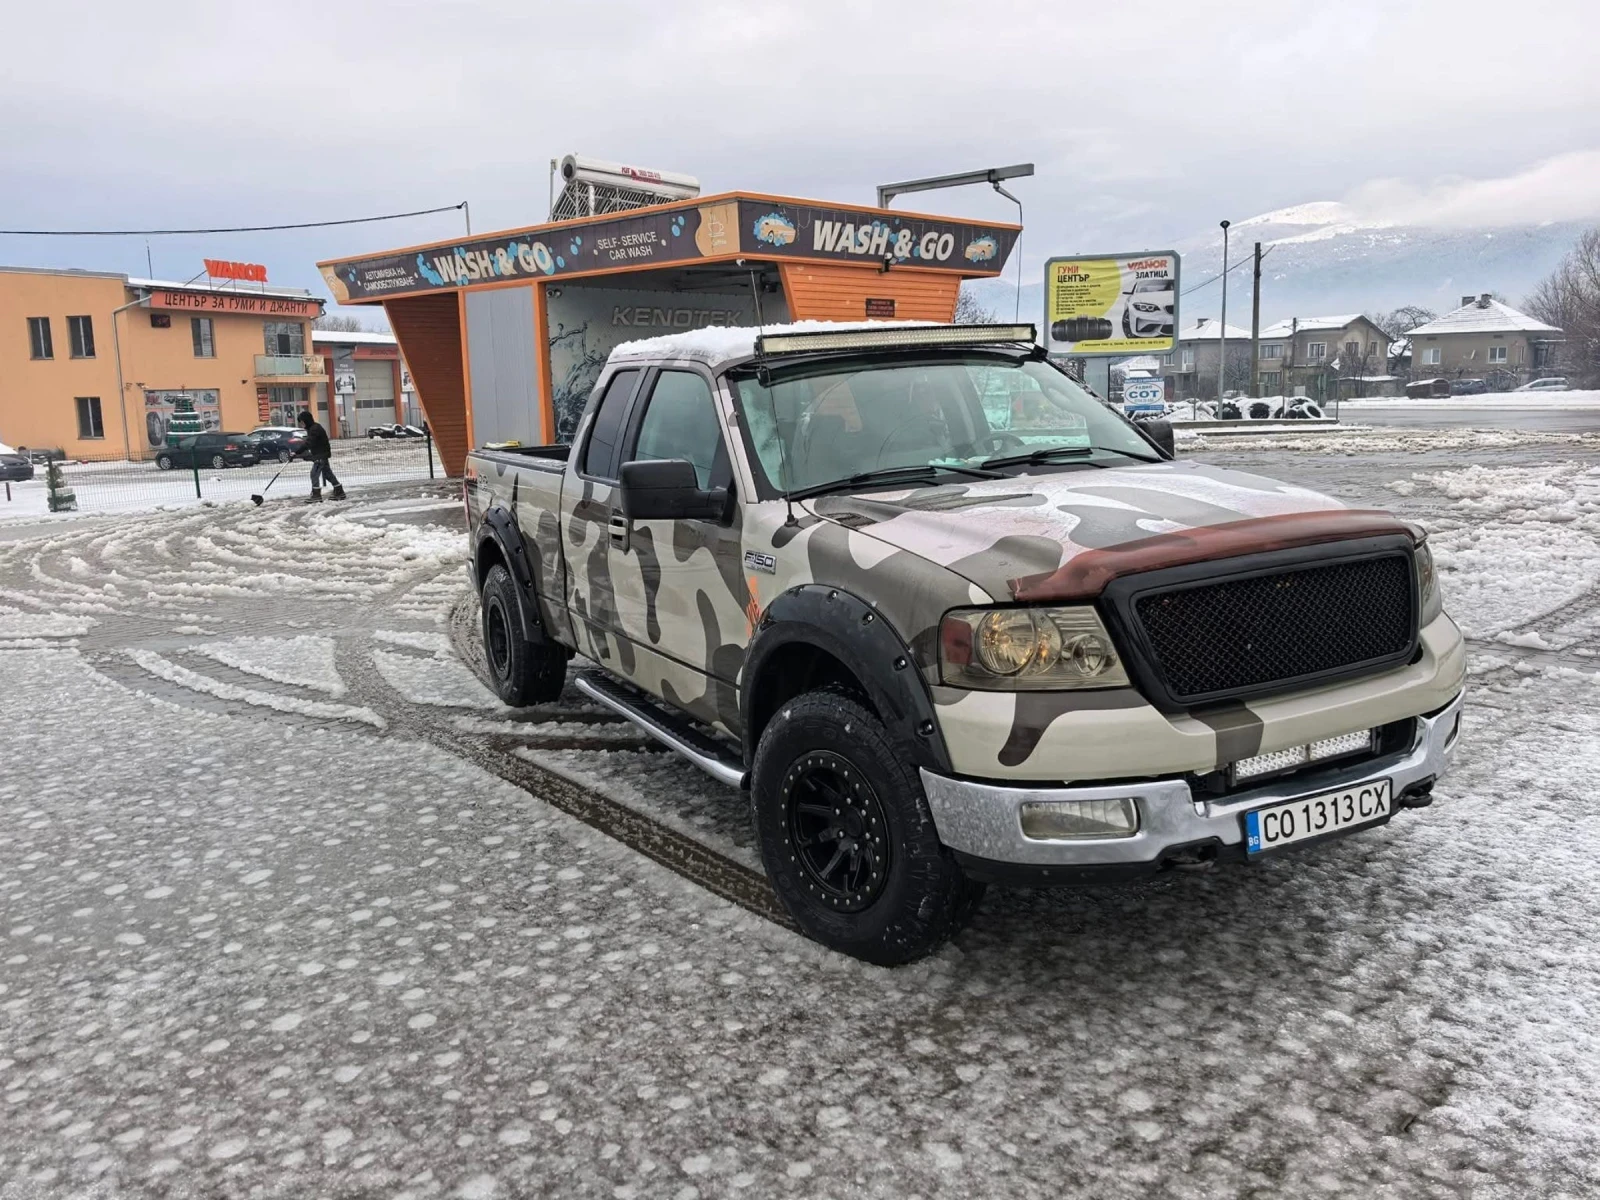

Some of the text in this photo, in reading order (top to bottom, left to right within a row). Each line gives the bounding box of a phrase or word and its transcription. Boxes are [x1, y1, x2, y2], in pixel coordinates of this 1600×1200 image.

[621, 232, 658, 246] SERVICE
[813, 219, 955, 261] WASH & GO
[609, 245, 653, 260] CAR WASH
[203, 258, 268, 282] VIANOR
[433, 242, 552, 283] WASH & GO
[1058, 266, 1079, 274] ГУМИ
[1127, 259, 1168, 270] VIANOR
[1058, 274, 1090, 283] ЦЕНТЪР
[1136, 270, 1168, 280] ЗЛАТИЦА
[164, 293, 308, 314] ЦЕНТЪР ЗА ГУМИ И ДЖАНТИ
[612, 306, 742, 328] KENOTEK
[1264, 784, 1386, 843] CO 1313 CX
[1248, 836, 1260, 846] BG
